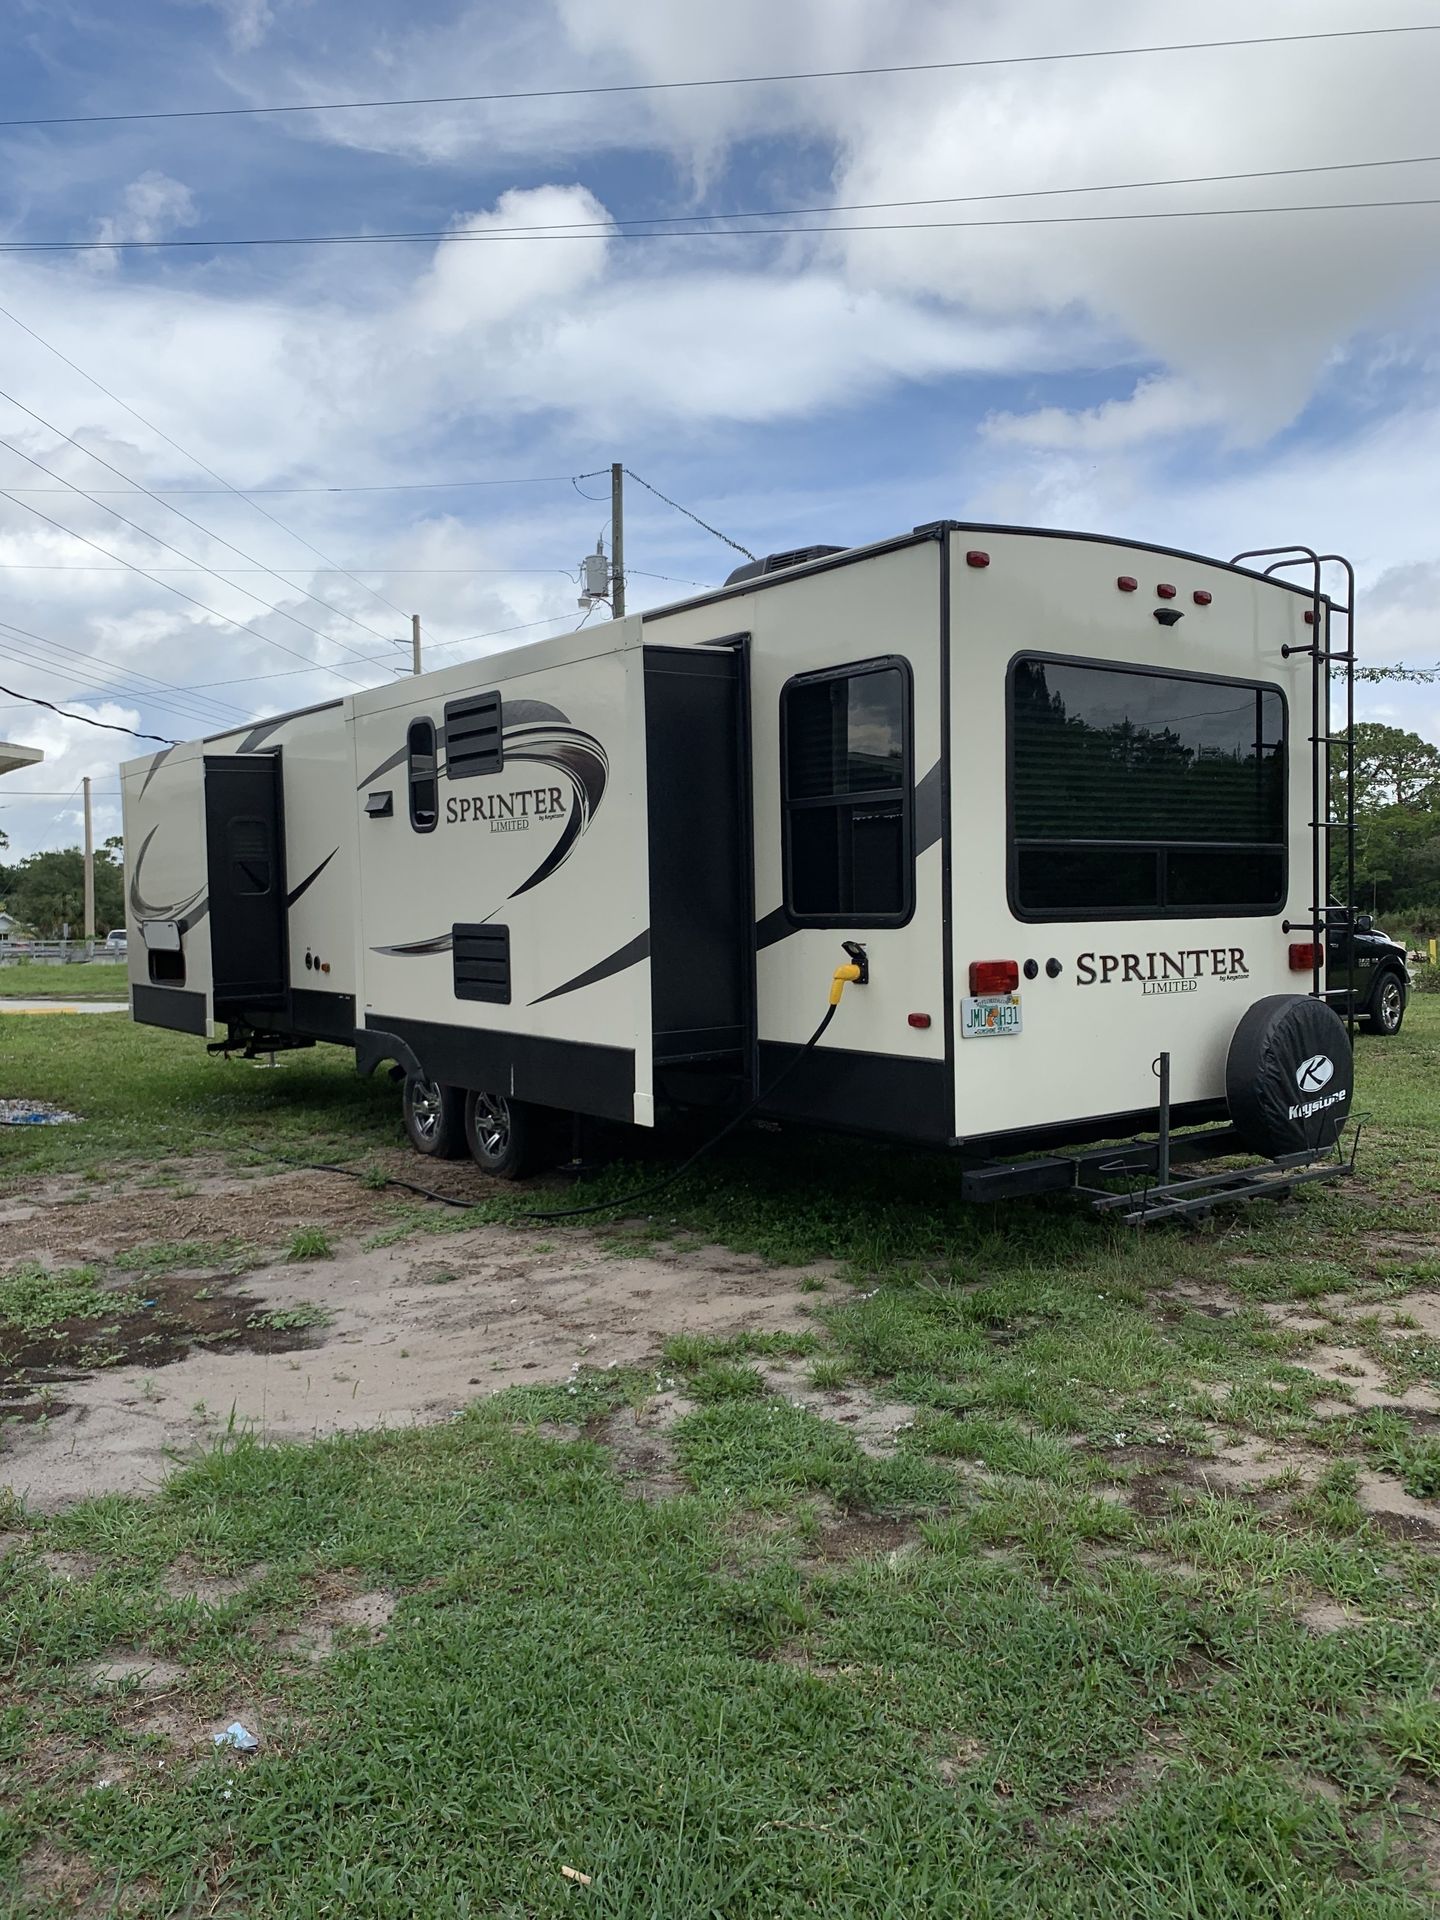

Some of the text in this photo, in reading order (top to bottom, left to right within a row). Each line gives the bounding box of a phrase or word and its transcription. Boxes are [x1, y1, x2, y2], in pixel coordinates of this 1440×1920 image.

[446, 787, 567, 824] SPRINTER
[490, 819, 529, 832] LIMITED
[1076, 947, 1250, 987] SPRINTER
[1142, 980, 1198, 994] LIMITED
[999, 1006, 1019, 1026] H31
